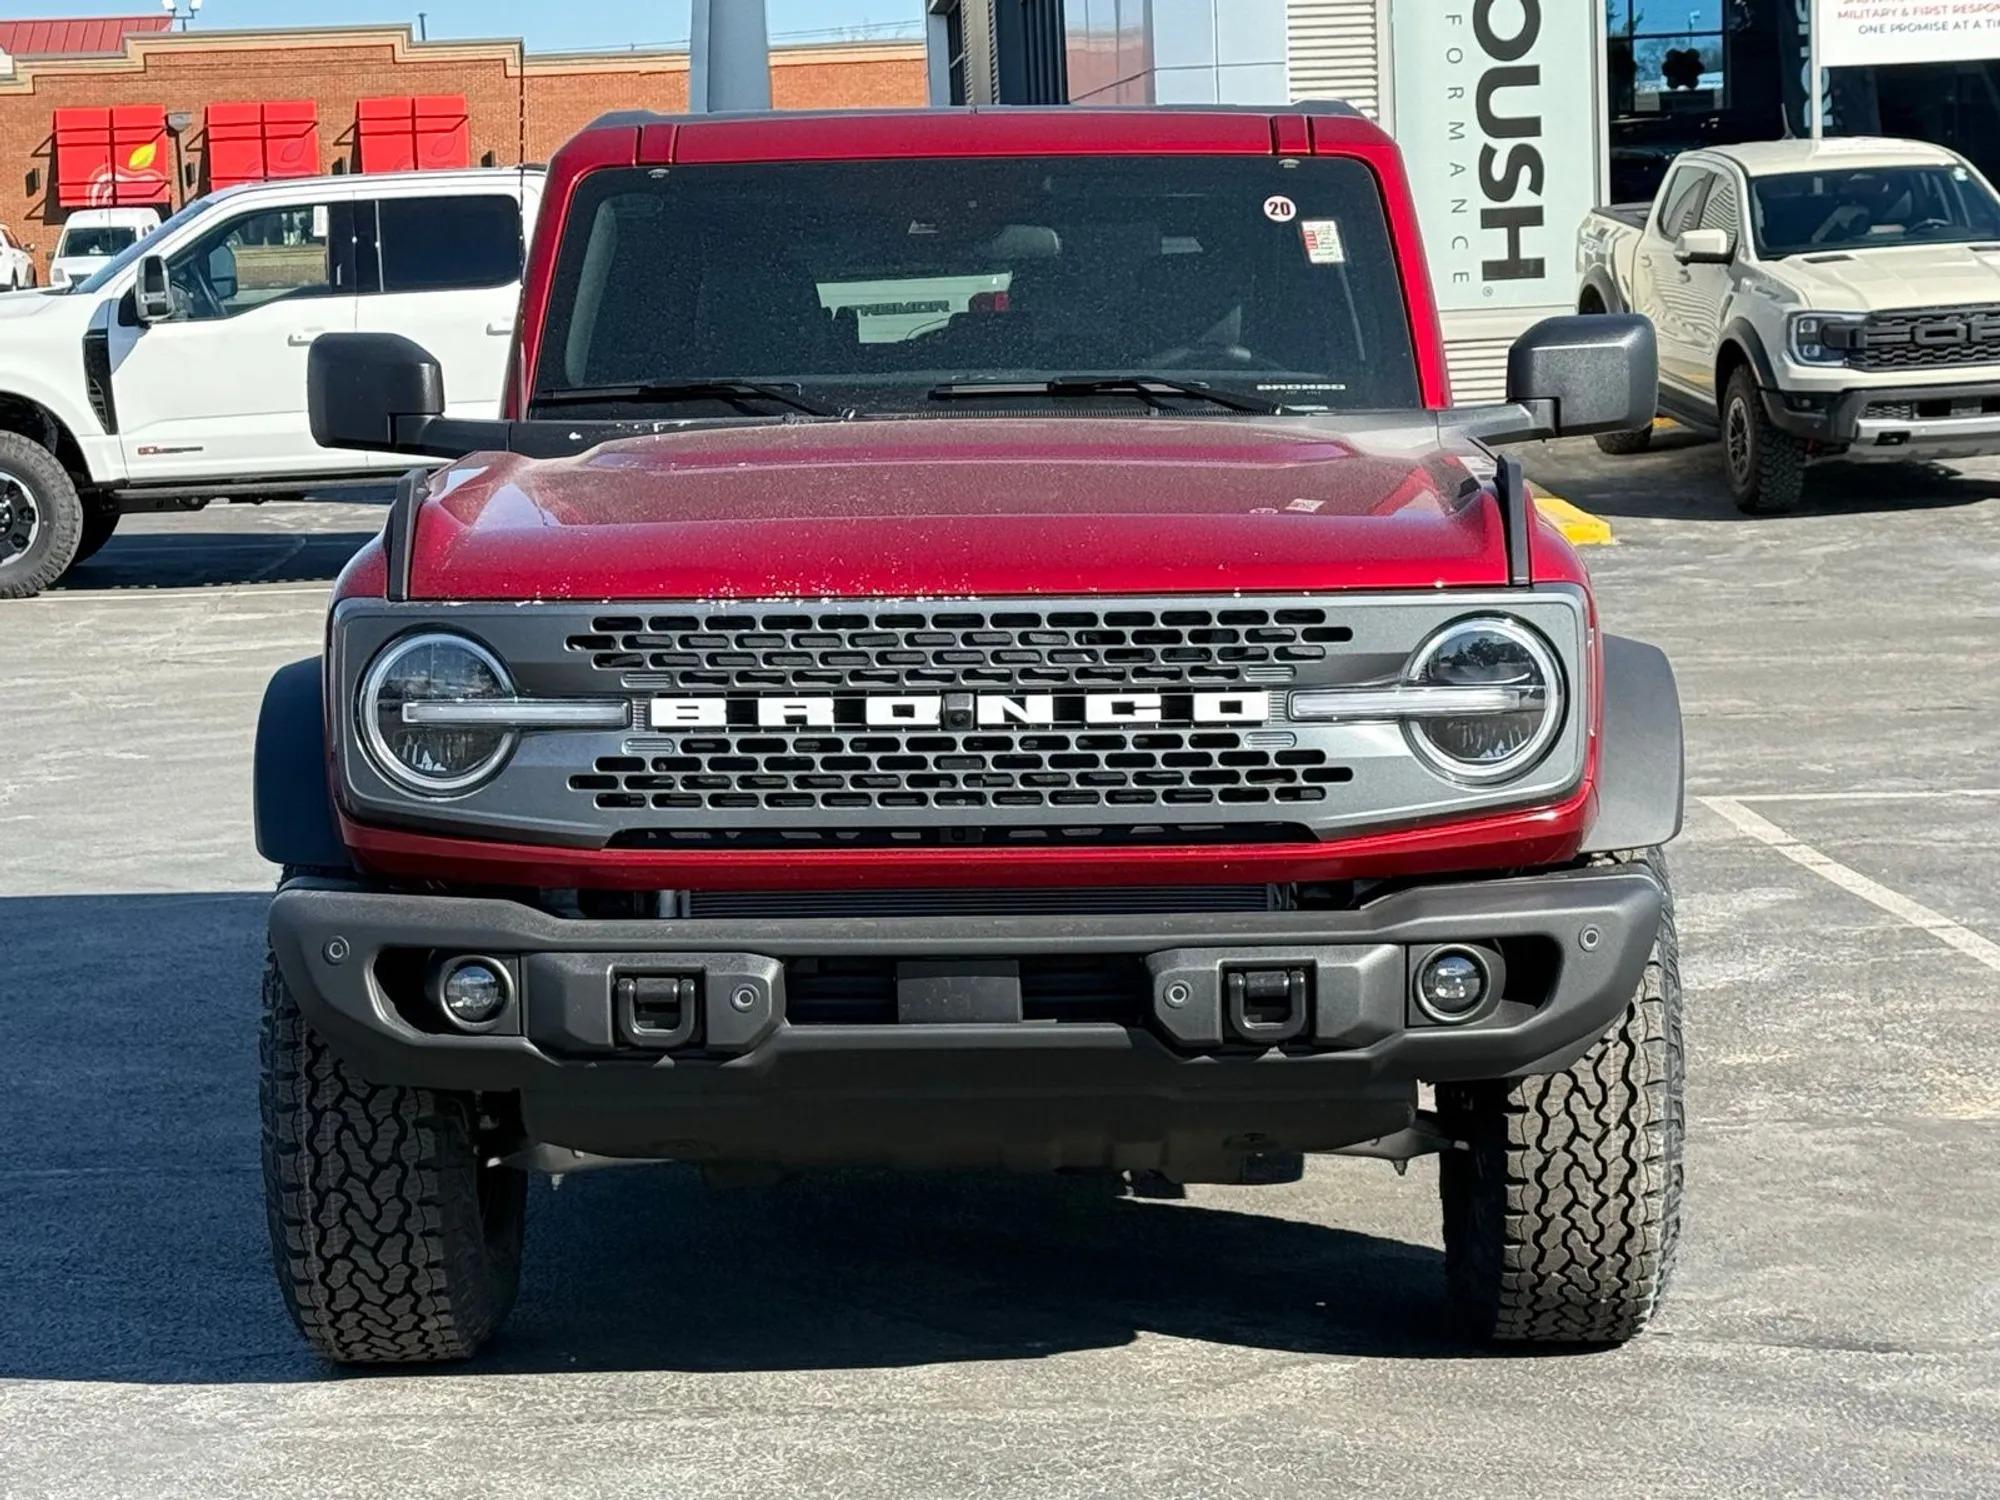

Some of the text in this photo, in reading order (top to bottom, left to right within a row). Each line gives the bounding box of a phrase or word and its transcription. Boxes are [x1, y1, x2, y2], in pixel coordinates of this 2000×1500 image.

[1837, 7, 1898, 20] MILITARY
[1901, 6, 1910, 17] &
[1912, 5, 1948, 17] FIRST
[1858, 23, 1886, 35] ONE
[1890, 21, 1949, 33] PROMISE
[1953, 19, 1969, 30] AT
[1972, 20, 1982, 29] A
[1445, 14, 1470, 284] FORMANCE
[1268, 201, 1291, 216] 20
[651, 691, 1269, 727] BRONCO
